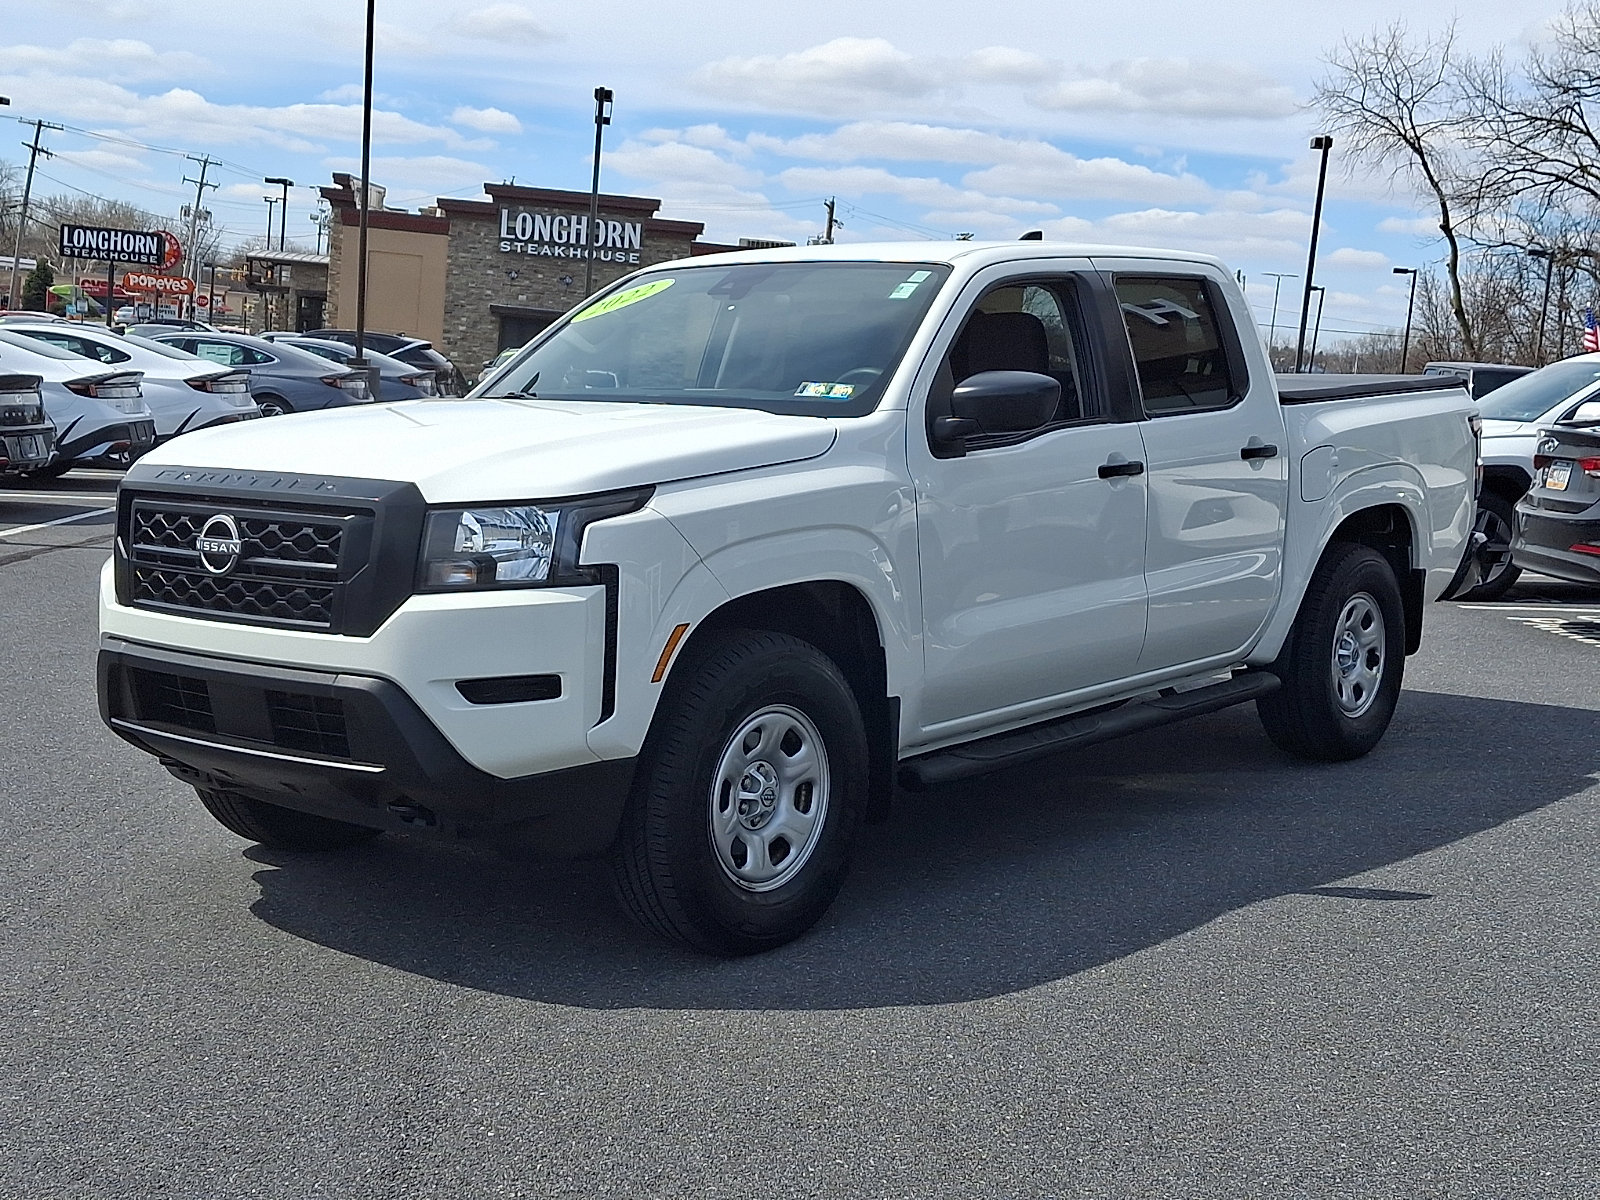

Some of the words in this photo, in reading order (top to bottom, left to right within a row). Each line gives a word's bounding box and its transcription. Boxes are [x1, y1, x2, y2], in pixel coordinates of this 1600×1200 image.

[500, 209, 641, 249] LONGHORN
[63, 226, 157, 254] LONGHORN
[64, 247, 157, 263] STEAKHOUSE
[500, 241, 640, 264] STEAKHOUSE
[197, 296, 207, 304] STOP
[196, 540, 239, 553] NISSAN
